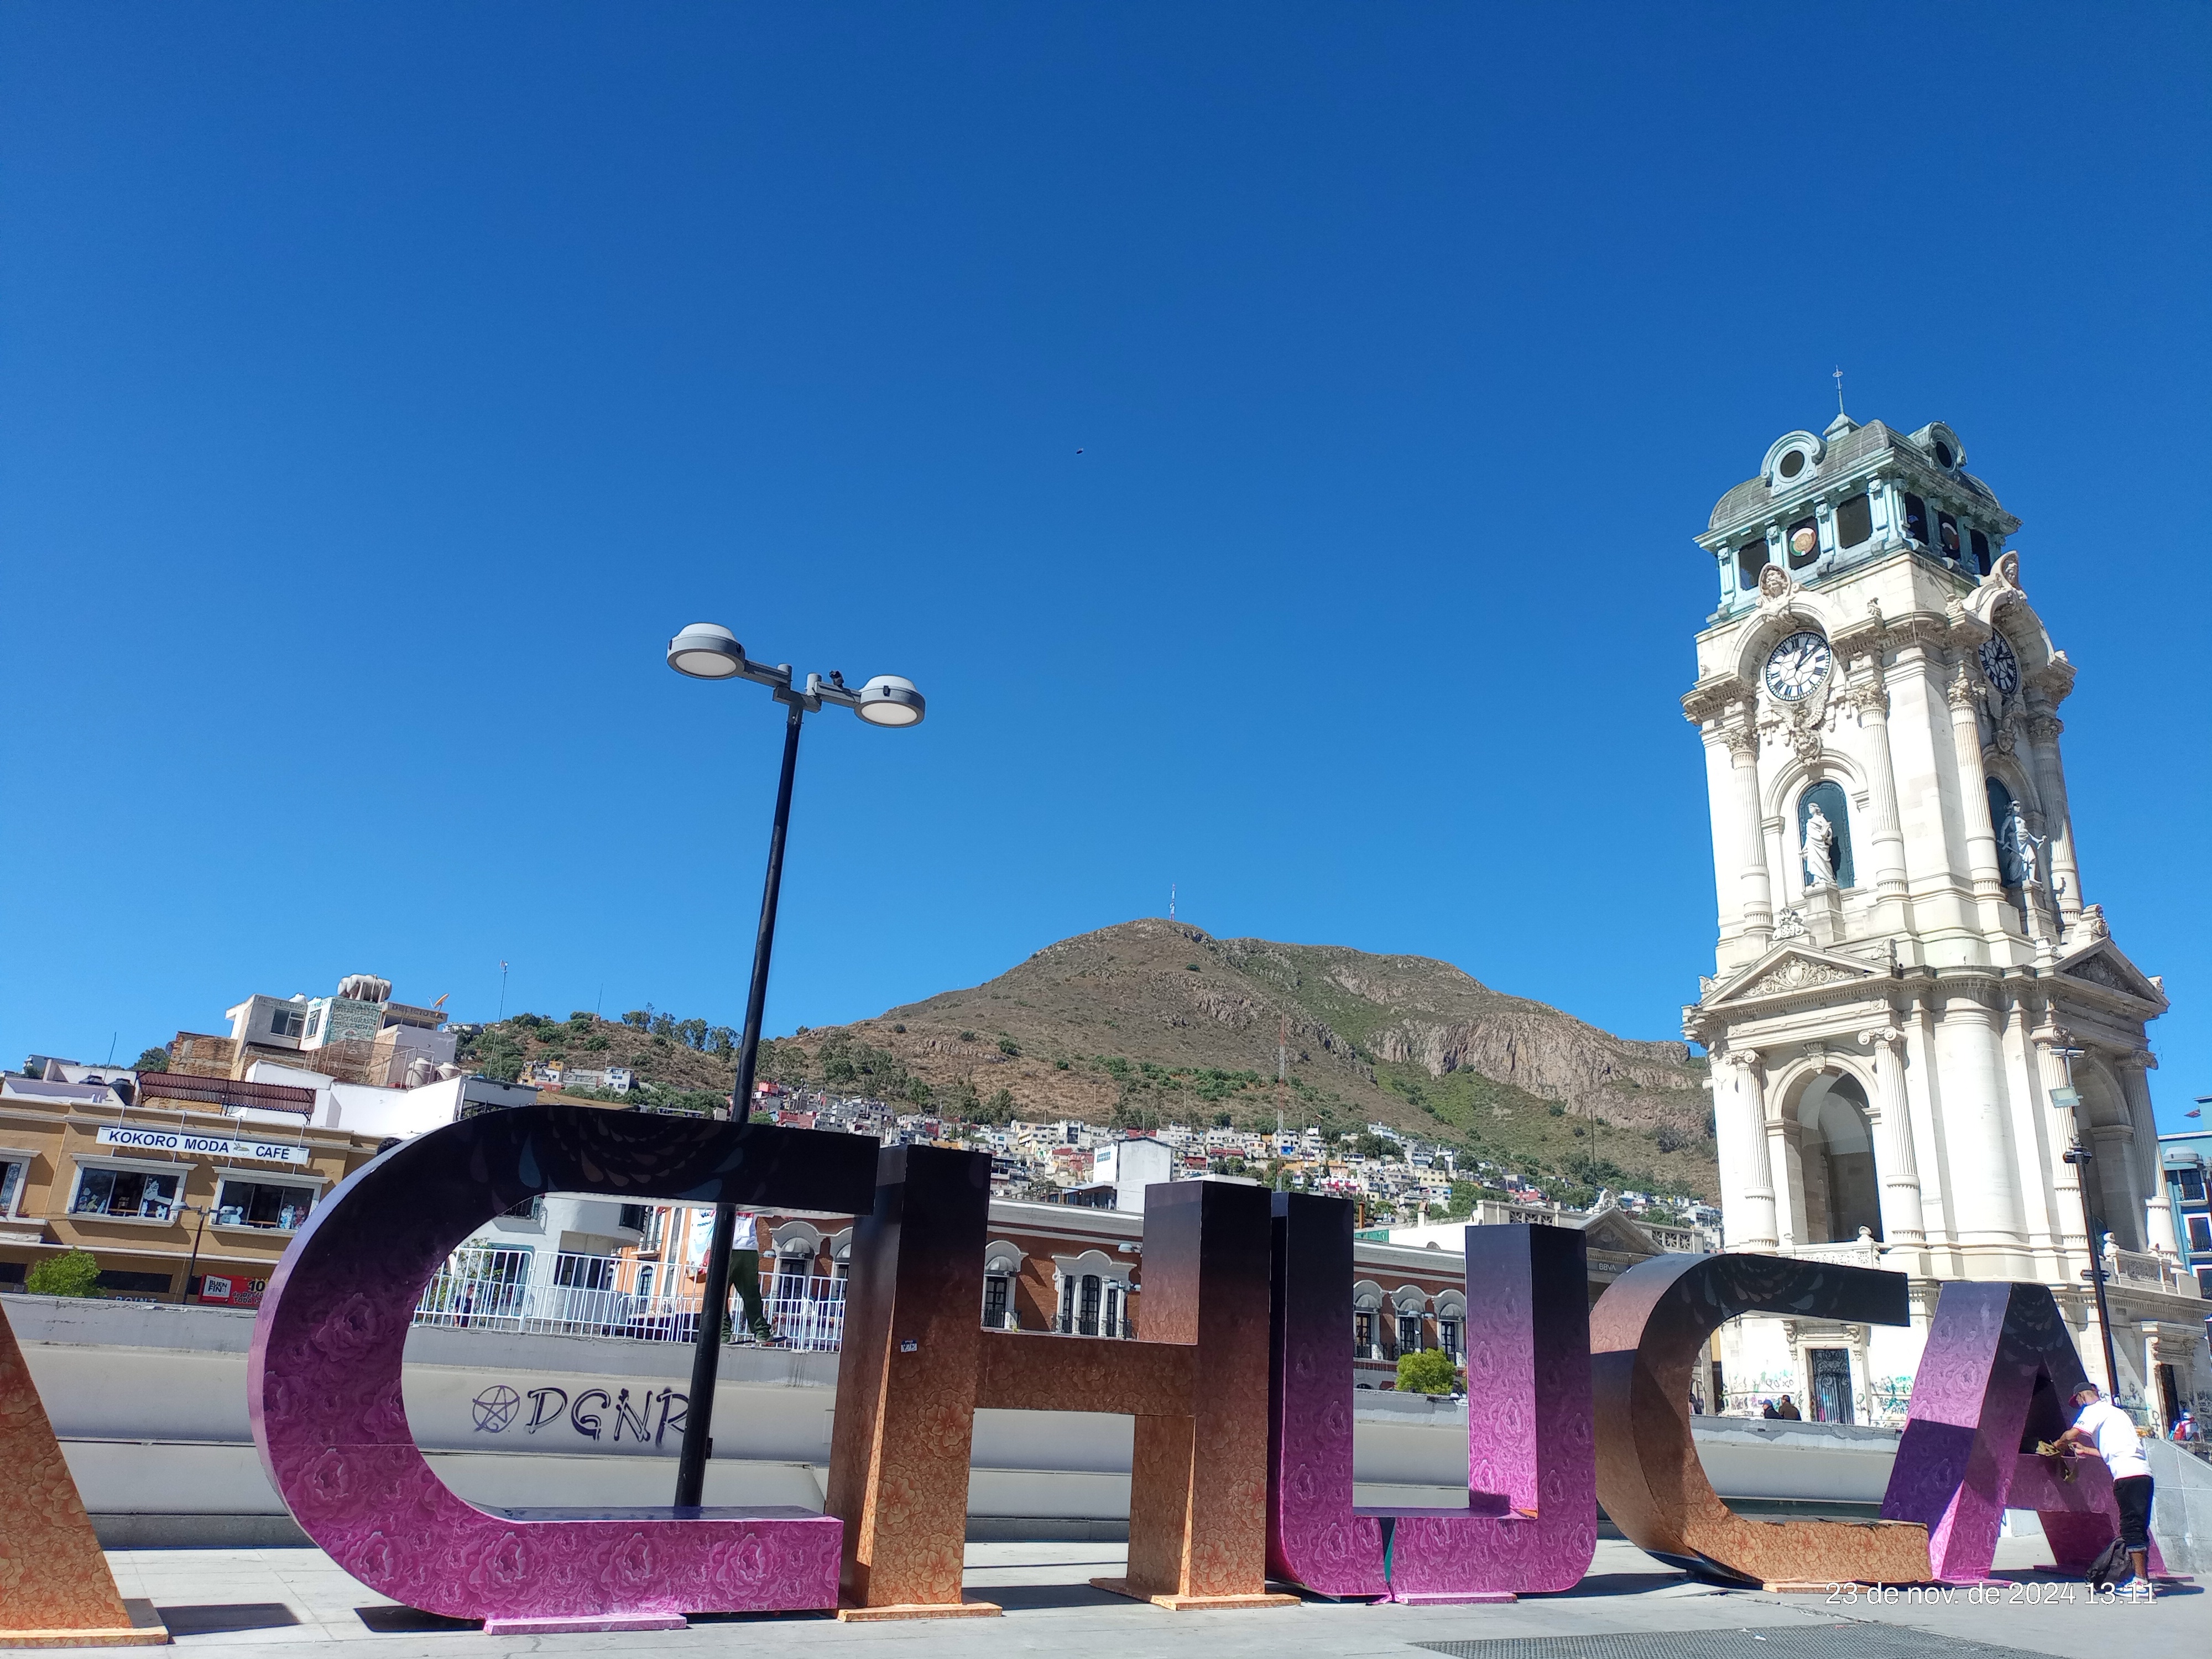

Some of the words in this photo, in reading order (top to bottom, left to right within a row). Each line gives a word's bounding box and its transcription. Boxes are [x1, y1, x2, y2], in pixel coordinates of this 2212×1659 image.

[109, 1131, 178, 1148] KOKORO
[184, 1138, 229, 1153] MODA
[255, 1146, 290, 1160] CAFÉ
[210, 1280, 227, 1288] BUEN
